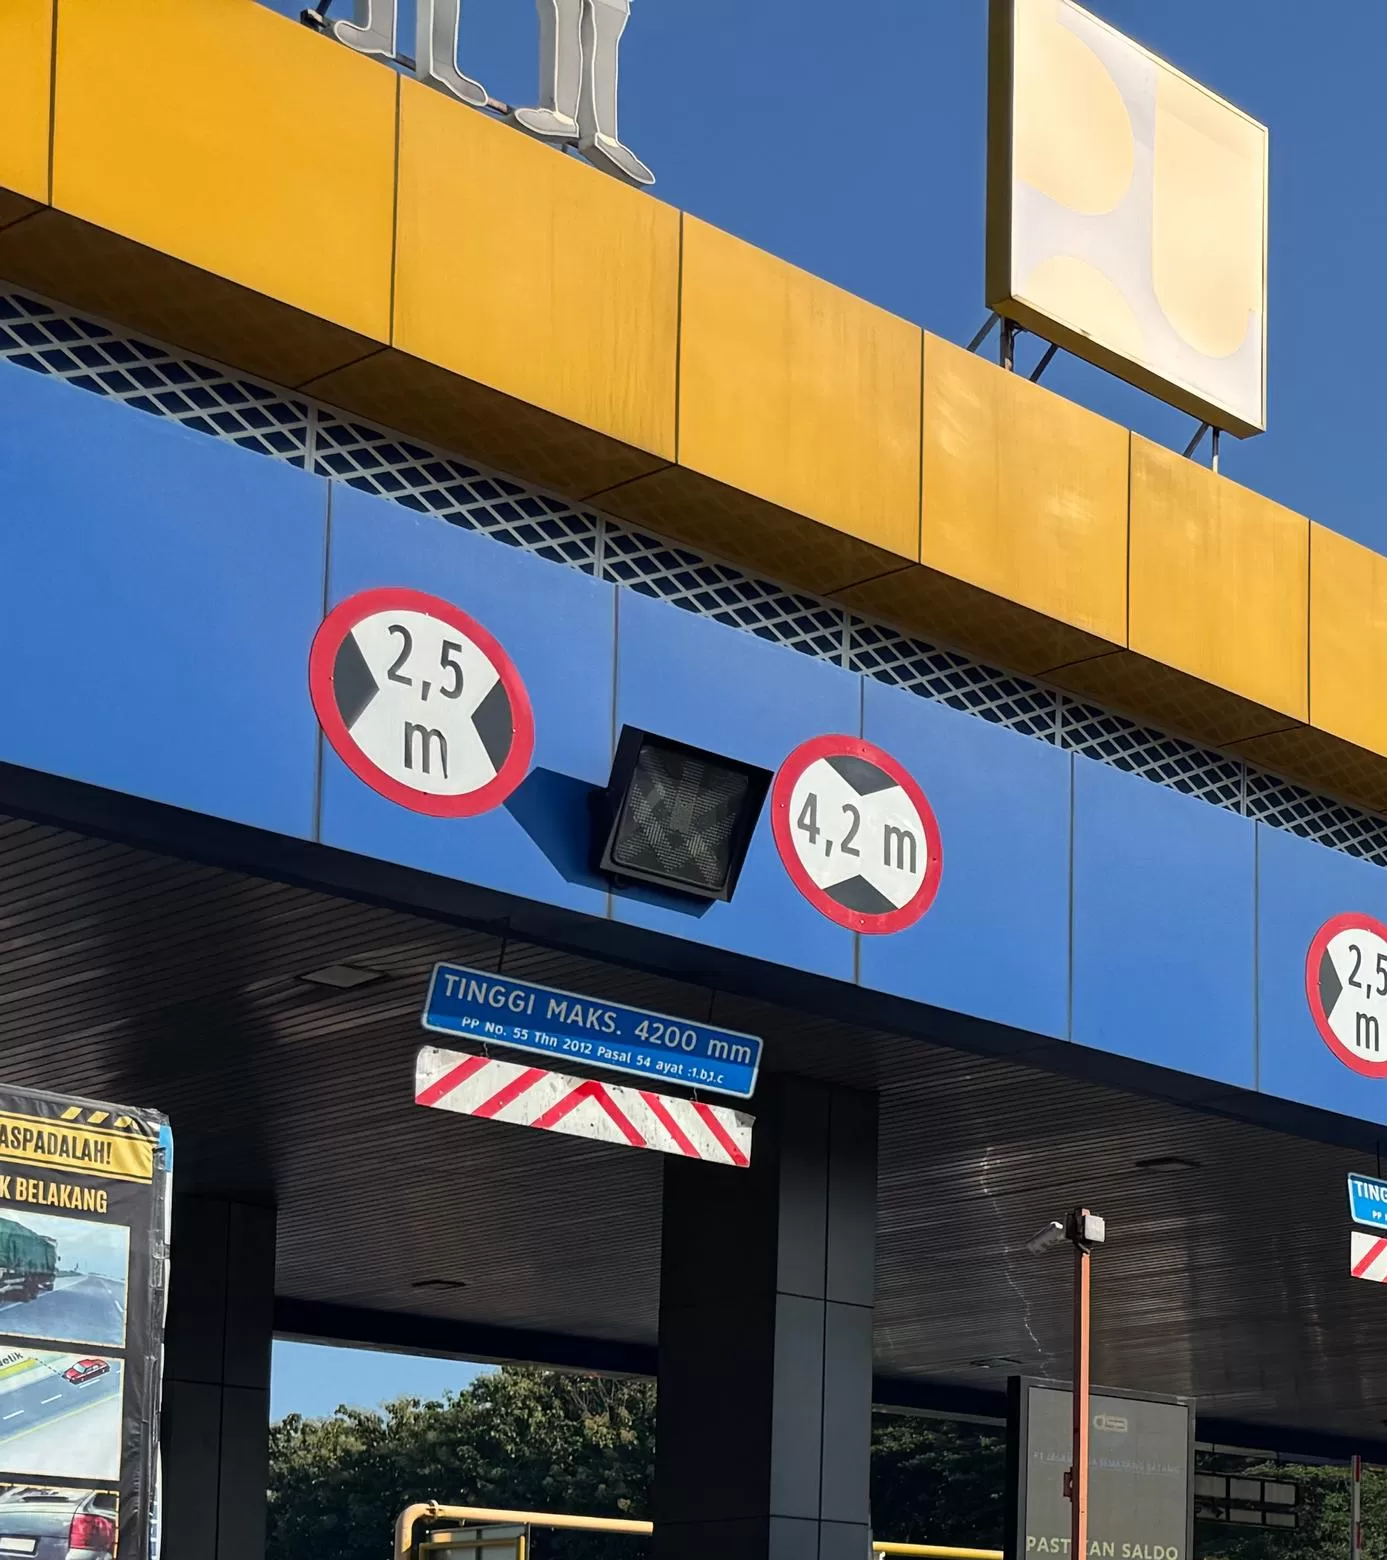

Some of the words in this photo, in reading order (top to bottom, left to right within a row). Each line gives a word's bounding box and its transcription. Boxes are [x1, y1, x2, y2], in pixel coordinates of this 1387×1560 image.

[387, 624, 464, 700] 2,5
[404, 720, 448, 779] m
[797, 793, 861, 857] 4,2
[883, 823, 917, 874] m
[444, 974, 535, 1015] TINGGI
[547, 998, 621, 1035] MAKS.
[635, 1019, 697, 1051] 4200
[708, 1039, 750, 1063] mm
[1356, 1011, 1379, 1052] m
[485, 1021, 506, 1037] No.
[513, 1028, 528, 1040] 55
[534, 1032, 557, 1047] Thn
[563, 1038, 592, 1055] 2012
[597, 1046, 631, 1064] Pasal
[636, 1054, 651, 1068] 54
[655, 1059, 684, 1076] ayat
[15, 1177, 108, 1213] BELAKANG
[1026, 1535, 1115, 1557] PASTAN
[1121, 1543, 1178, 1560] SALDO
